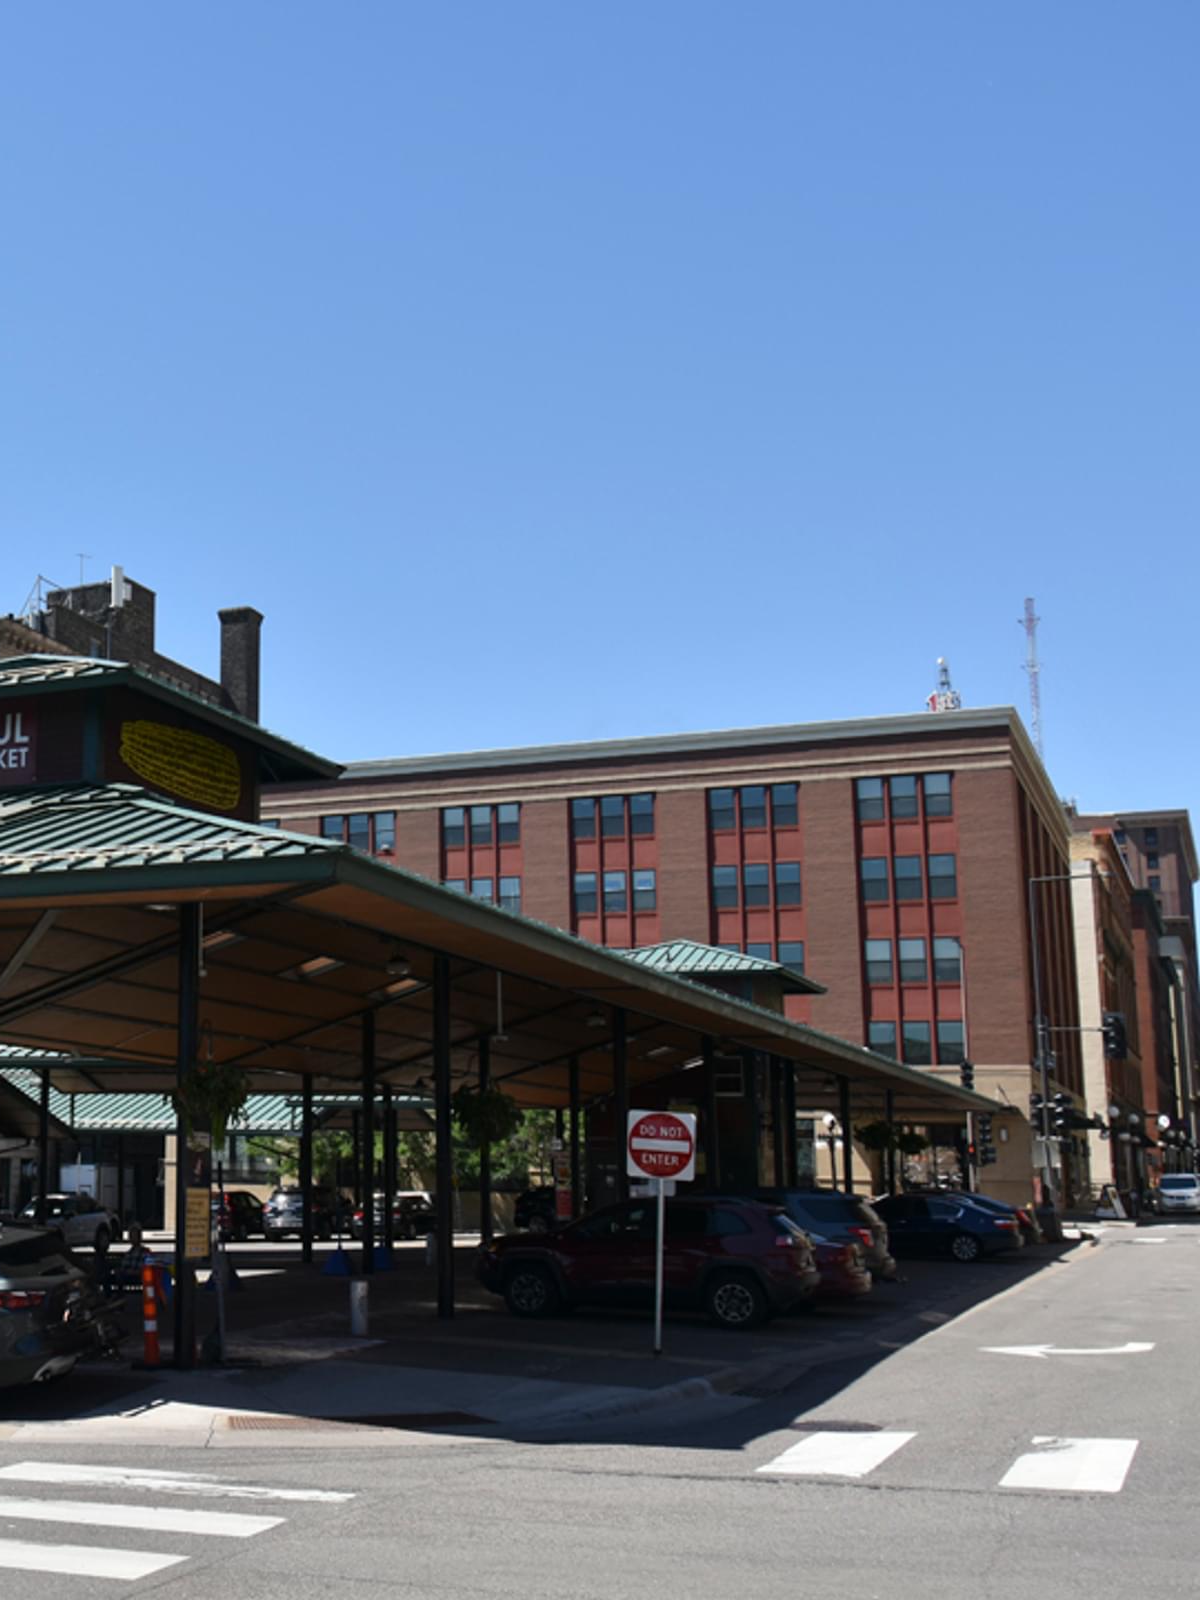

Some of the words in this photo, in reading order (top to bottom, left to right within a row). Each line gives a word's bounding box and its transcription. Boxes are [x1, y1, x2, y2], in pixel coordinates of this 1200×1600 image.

[640, 1125, 656, 1136] DO
[660, 1126, 683, 1138] NOT
[641, 1152, 680, 1166] ENTER
